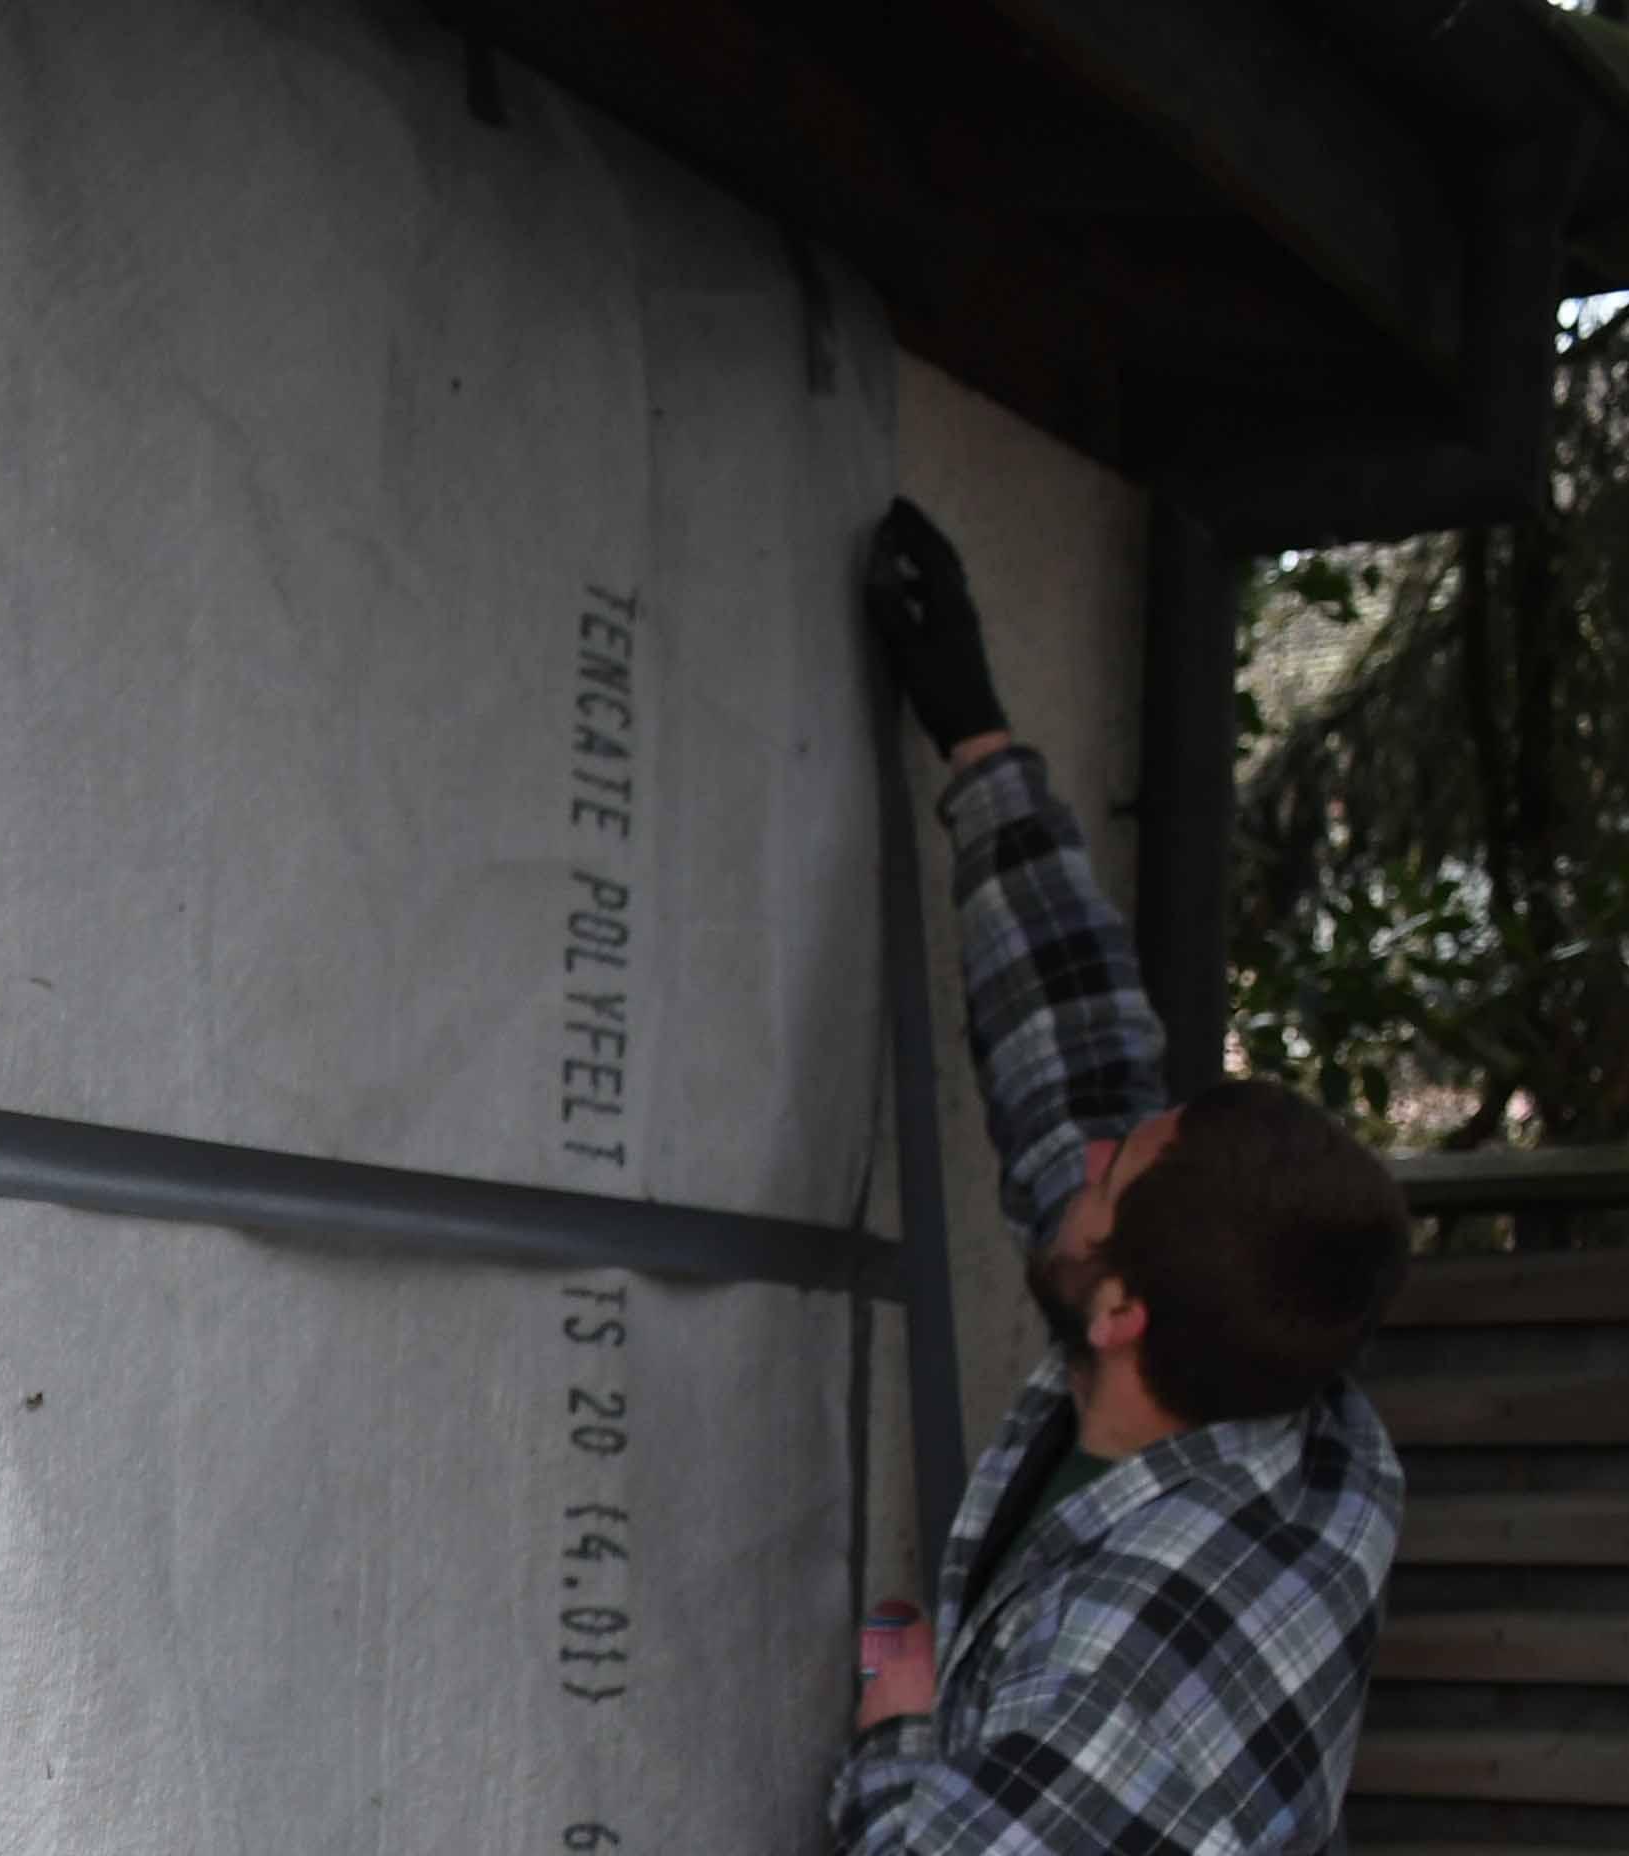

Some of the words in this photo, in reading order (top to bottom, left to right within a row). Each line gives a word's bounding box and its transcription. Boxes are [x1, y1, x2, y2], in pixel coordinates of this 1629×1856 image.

[570, 583, 639, 839] TENCATE
[562, 867, 629, 1168] POLYFELT
[561, 1284, 628, 1350] TS
[570, 1390, 628, 1457] 20
[561, 1506, 629, 1705] (4.01)
